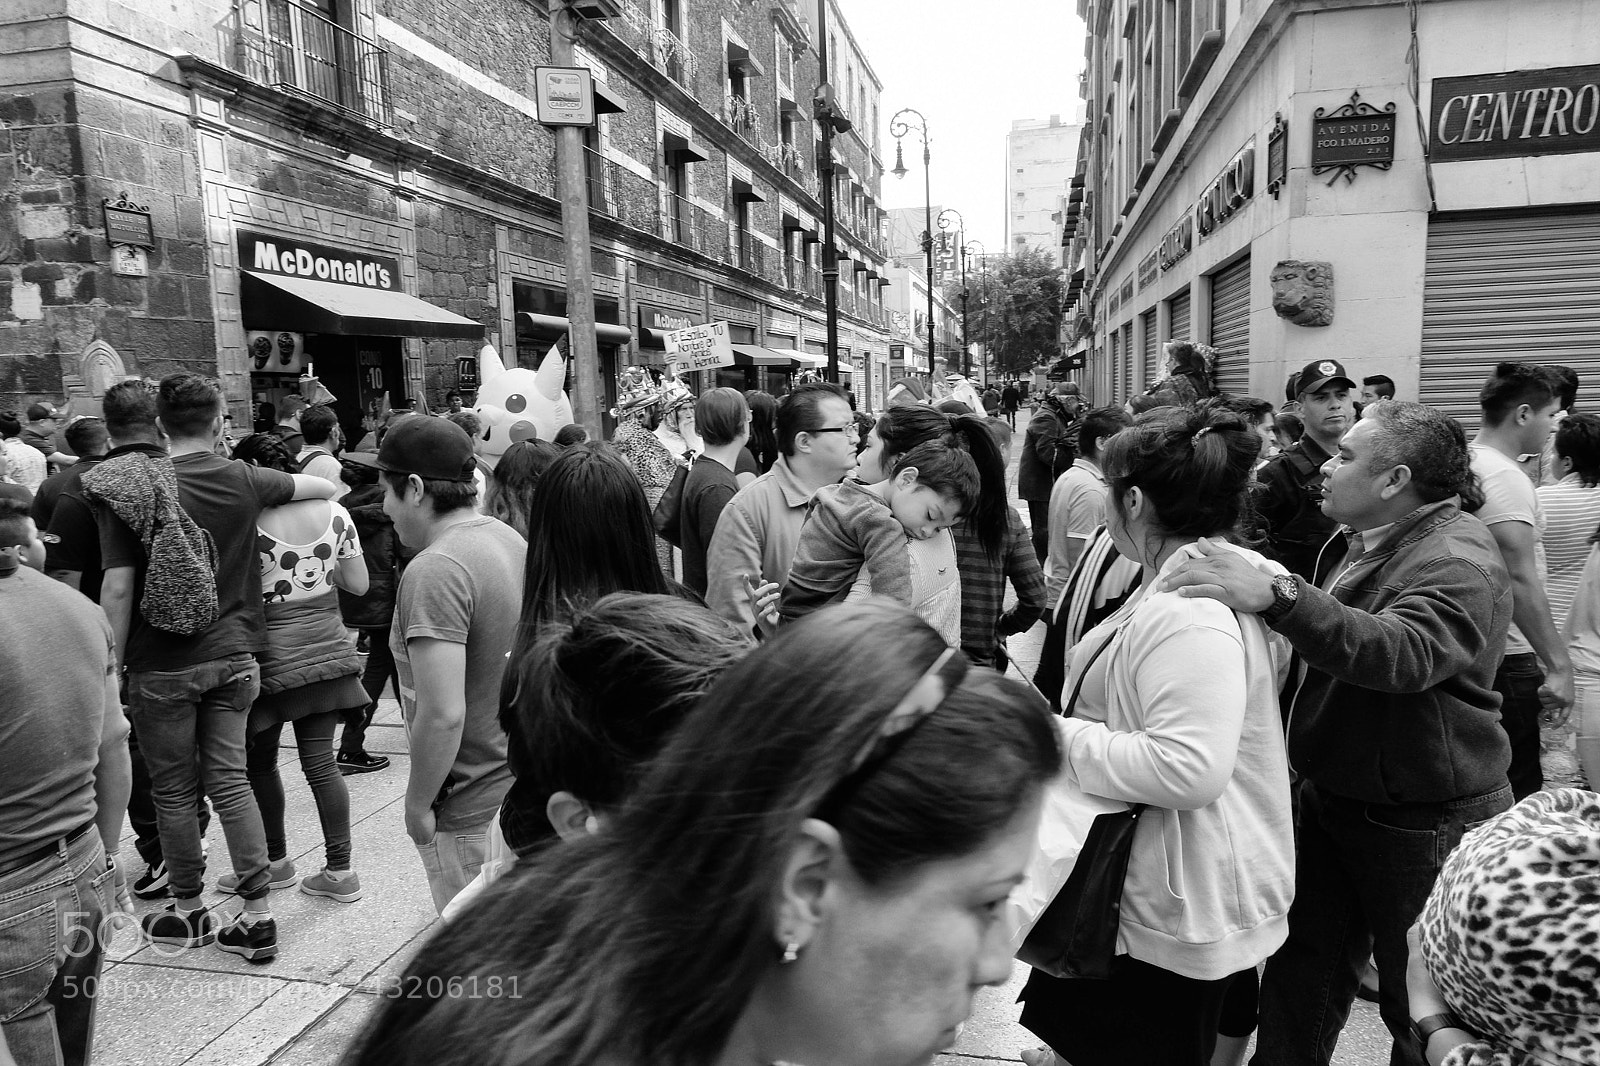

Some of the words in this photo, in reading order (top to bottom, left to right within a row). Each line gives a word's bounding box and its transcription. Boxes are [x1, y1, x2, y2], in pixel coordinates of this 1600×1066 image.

[1318, 123, 1390, 135] AVENIDA
[1437, 83, 1600, 145] CENTRO
[1317, 139, 1340, 148] FCO.
[1347, 136, 1390, 146] MADERO
[254, 241, 391, 289] McDonald's
